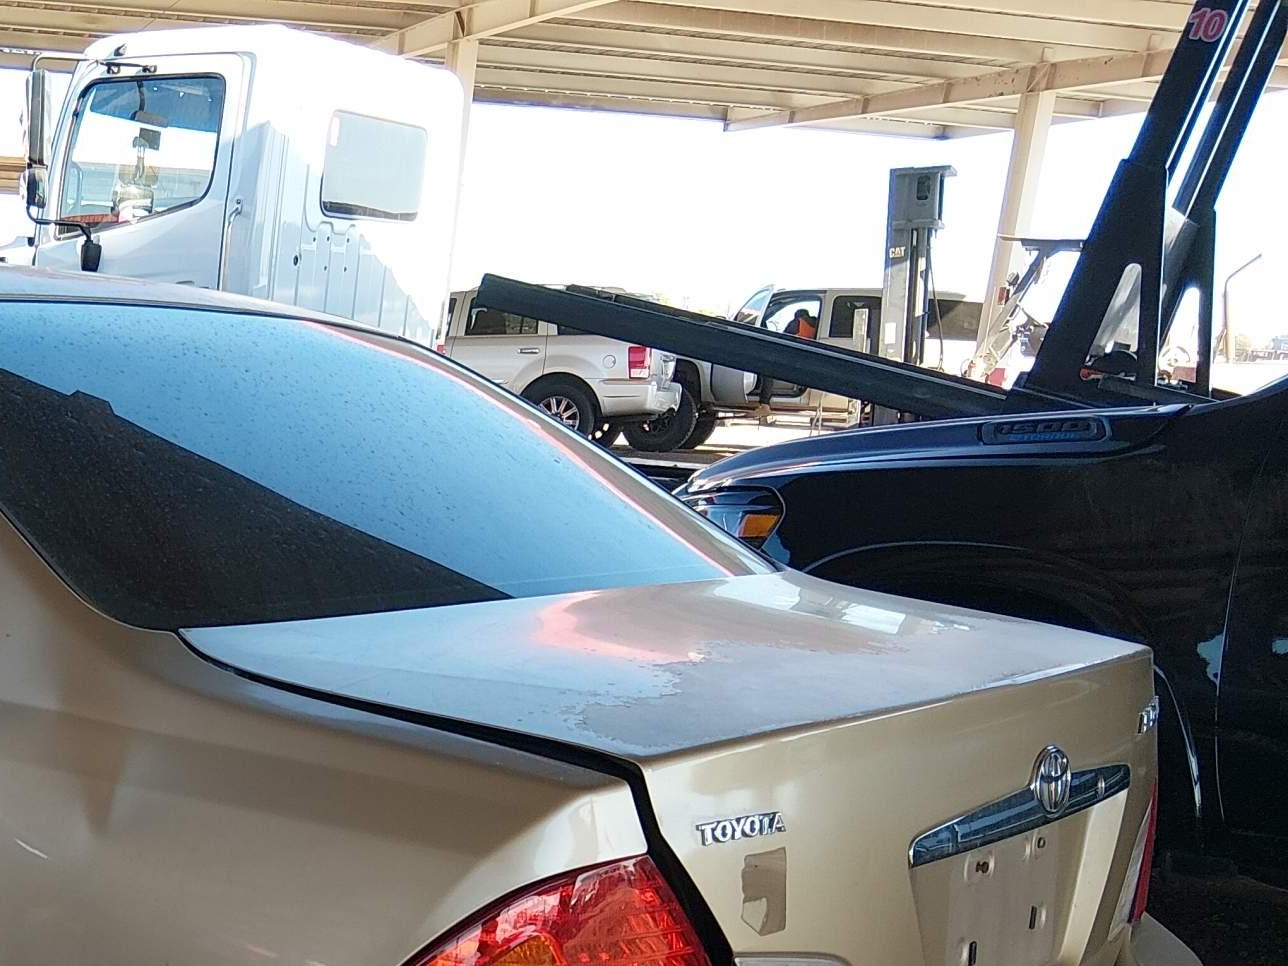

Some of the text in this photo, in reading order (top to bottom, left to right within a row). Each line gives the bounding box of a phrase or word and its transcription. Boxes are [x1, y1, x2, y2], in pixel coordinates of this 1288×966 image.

[1189, 8, 1228, 42] 10
[889, 246, 906, 258] CAT
[696, 811, 786, 846] TOYOTA
